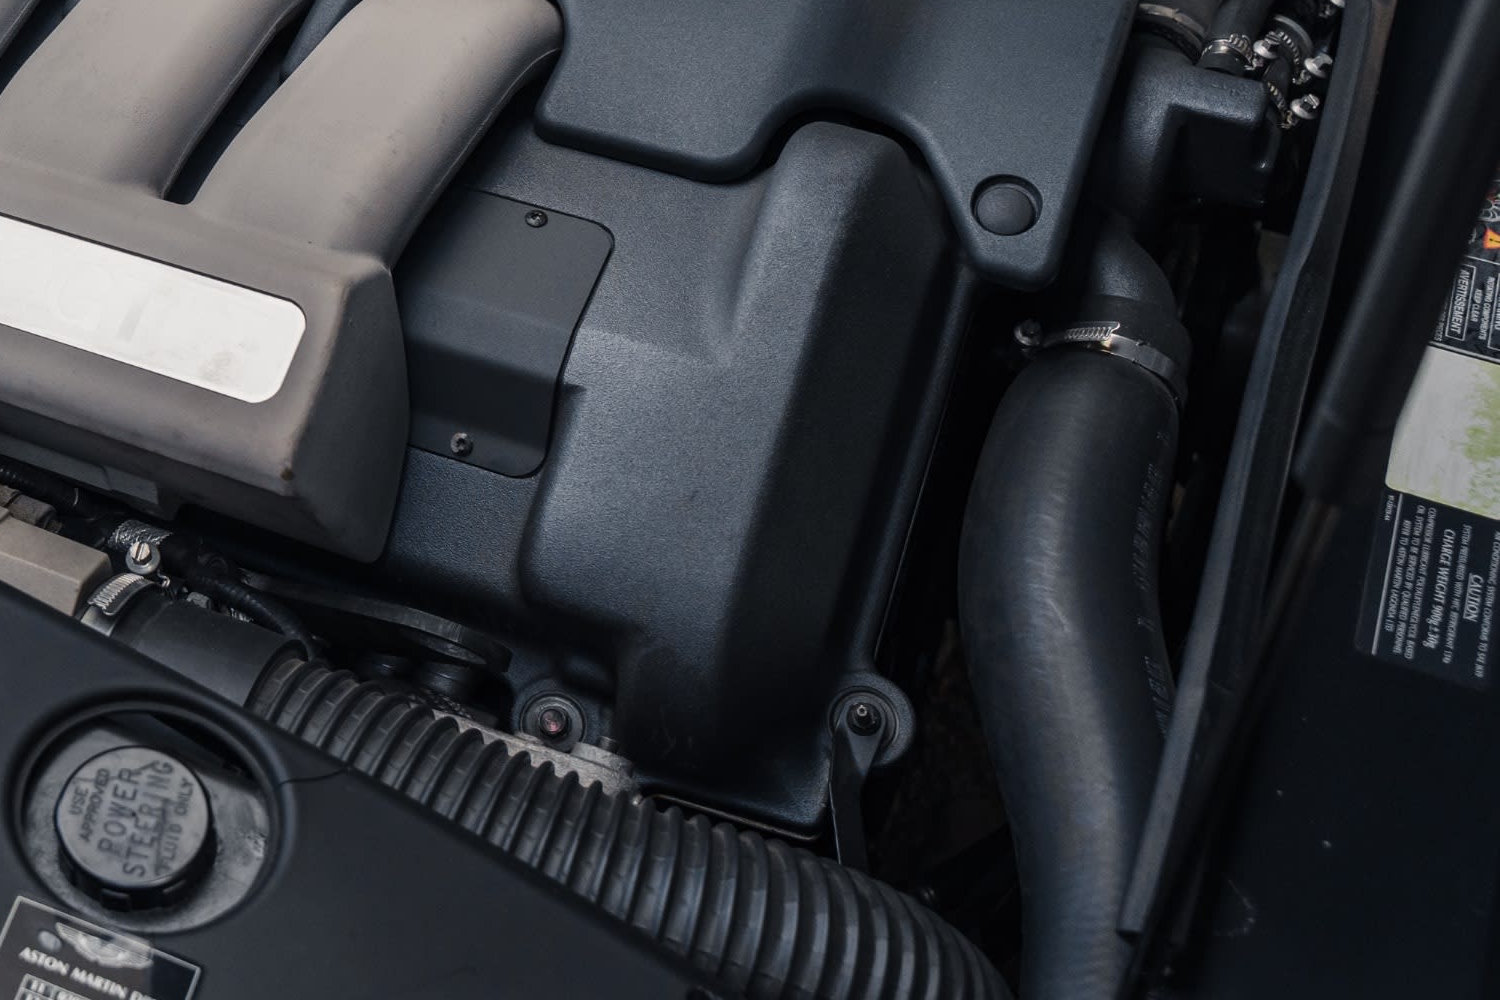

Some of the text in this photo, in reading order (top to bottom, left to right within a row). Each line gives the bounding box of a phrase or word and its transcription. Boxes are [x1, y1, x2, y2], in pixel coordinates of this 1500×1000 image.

[1451, 270, 1470, 334] AVERTISSEMENT
[1471, 289, 1482, 322] KEEP CLEAR
[1479, 276, 1495, 340] ROTATING COMPONENTS
[1399, 537, 1409, 545] TO
[1413, 516, 1423, 536] SYSTEM
[1461, 525, 1472, 544] SYSTEM
[1396, 546, 1407, 566] ASTON
[1439, 529, 1456, 566] CHARGE
[1392, 566, 1402, 589] MARTIN
[1433, 567, 1450, 605] WEIGHT
[1452, 582, 1463, 597] WITH
[1465, 574, 1484, 622] CAUTION
[1485, 586, 1496, 607] SYSTEM
[1478, 642, 1488, 652] TO
[68, 785, 88, 815] USE
[79, 768, 110, 843] APPROVED
[97, 767, 142, 858] POWER
[174, 778, 194, 817] ONLY
[122, 760, 174, 878] STEERING
[18, 946, 70, 976] ASTON
[69, 966, 128, 999] MARTIN
